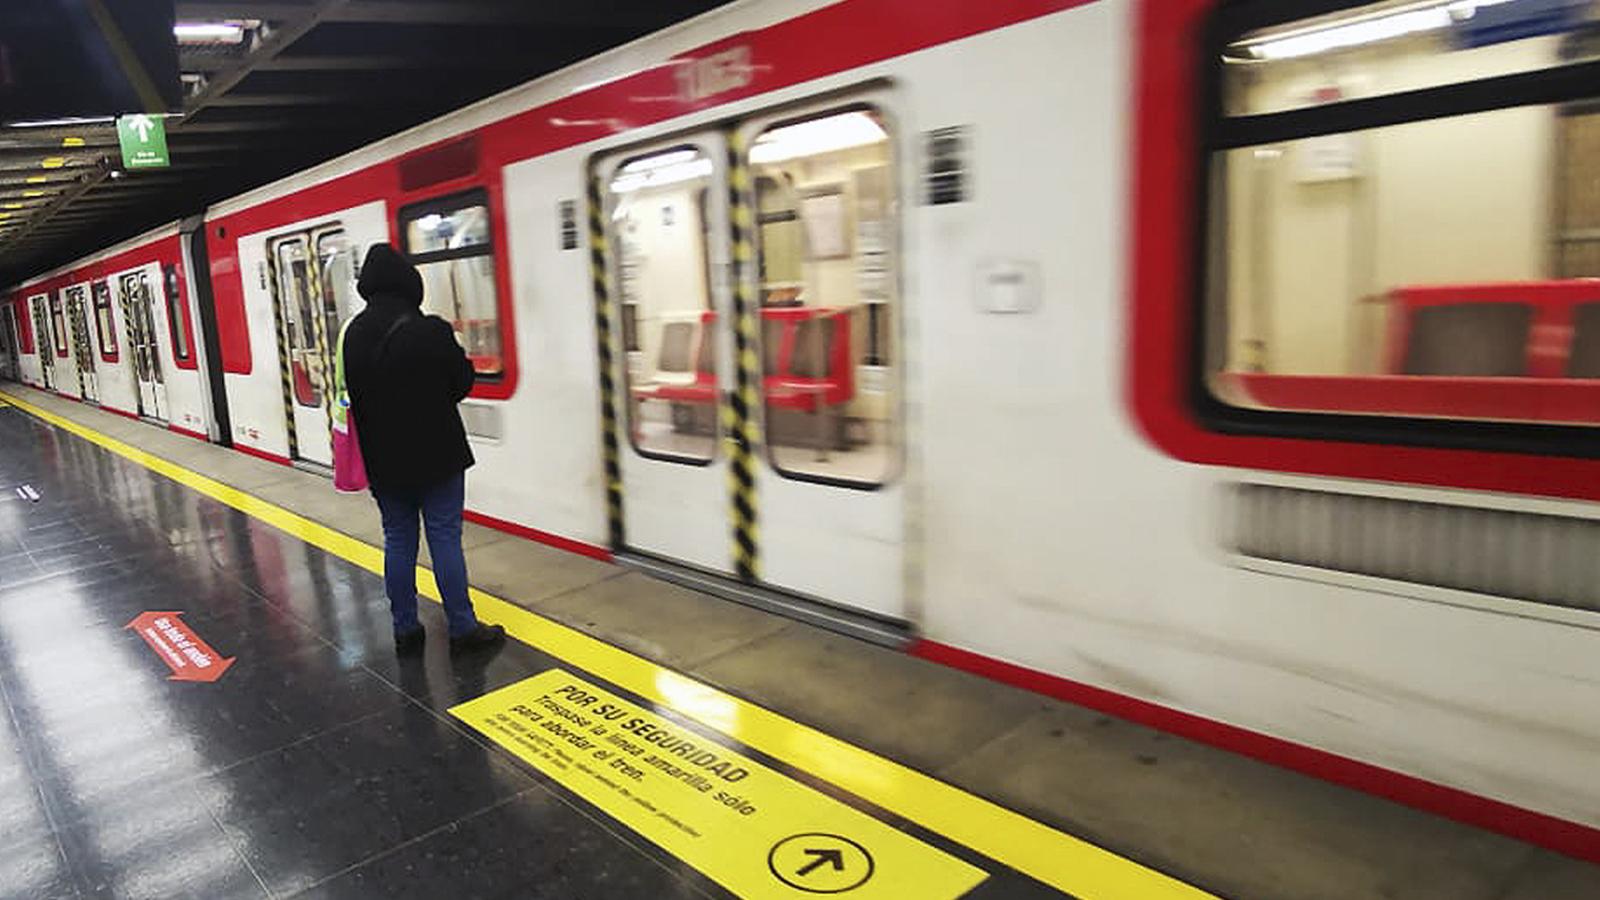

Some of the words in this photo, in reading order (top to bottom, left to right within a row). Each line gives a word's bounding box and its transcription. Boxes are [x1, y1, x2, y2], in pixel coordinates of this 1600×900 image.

[508, 705, 544, 721] para
[540, 721, 597, 749] abordar
[592, 750, 615, 760] el
[609, 758, 643, 782] tren.
[533, 695, 592, 727] Traspase
[590, 724, 608, 735] la
[643, 755, 714, 793] amarilla
[713, 791, 757, 816] sólo
[554, 685, 598, 707] POR
[593, 704, 629, 720] SU
[621, 718, 749, 783] SEGURIDAD
